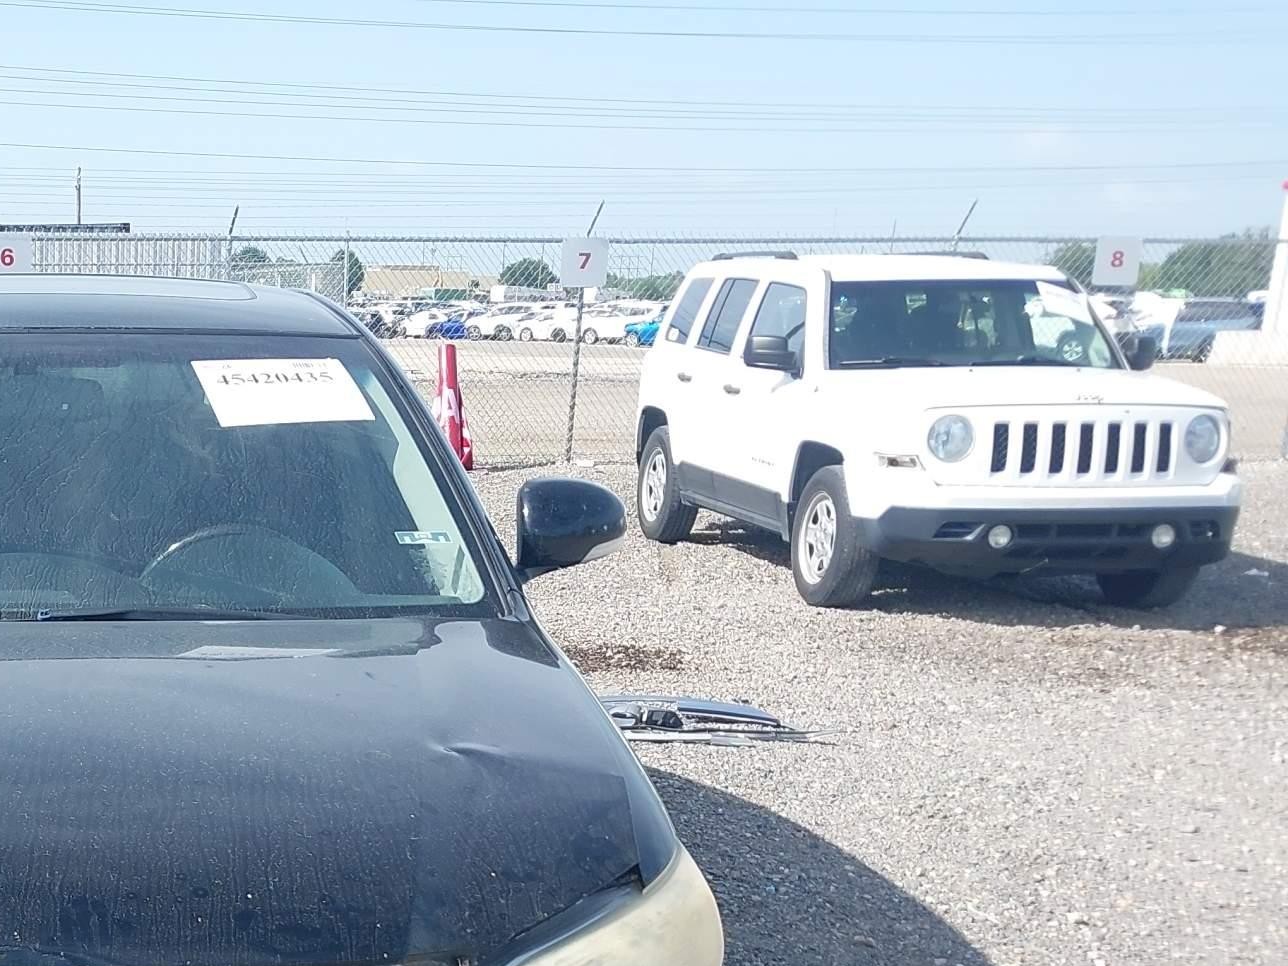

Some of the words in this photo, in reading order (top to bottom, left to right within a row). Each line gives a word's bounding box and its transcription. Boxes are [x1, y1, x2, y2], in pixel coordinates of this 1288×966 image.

[0, 248, 15, 267] 6
[578, 252, 592, 270] 7
[1111, 250, 1124, 268] 8
[216, 371, 334, 385] 45420435
